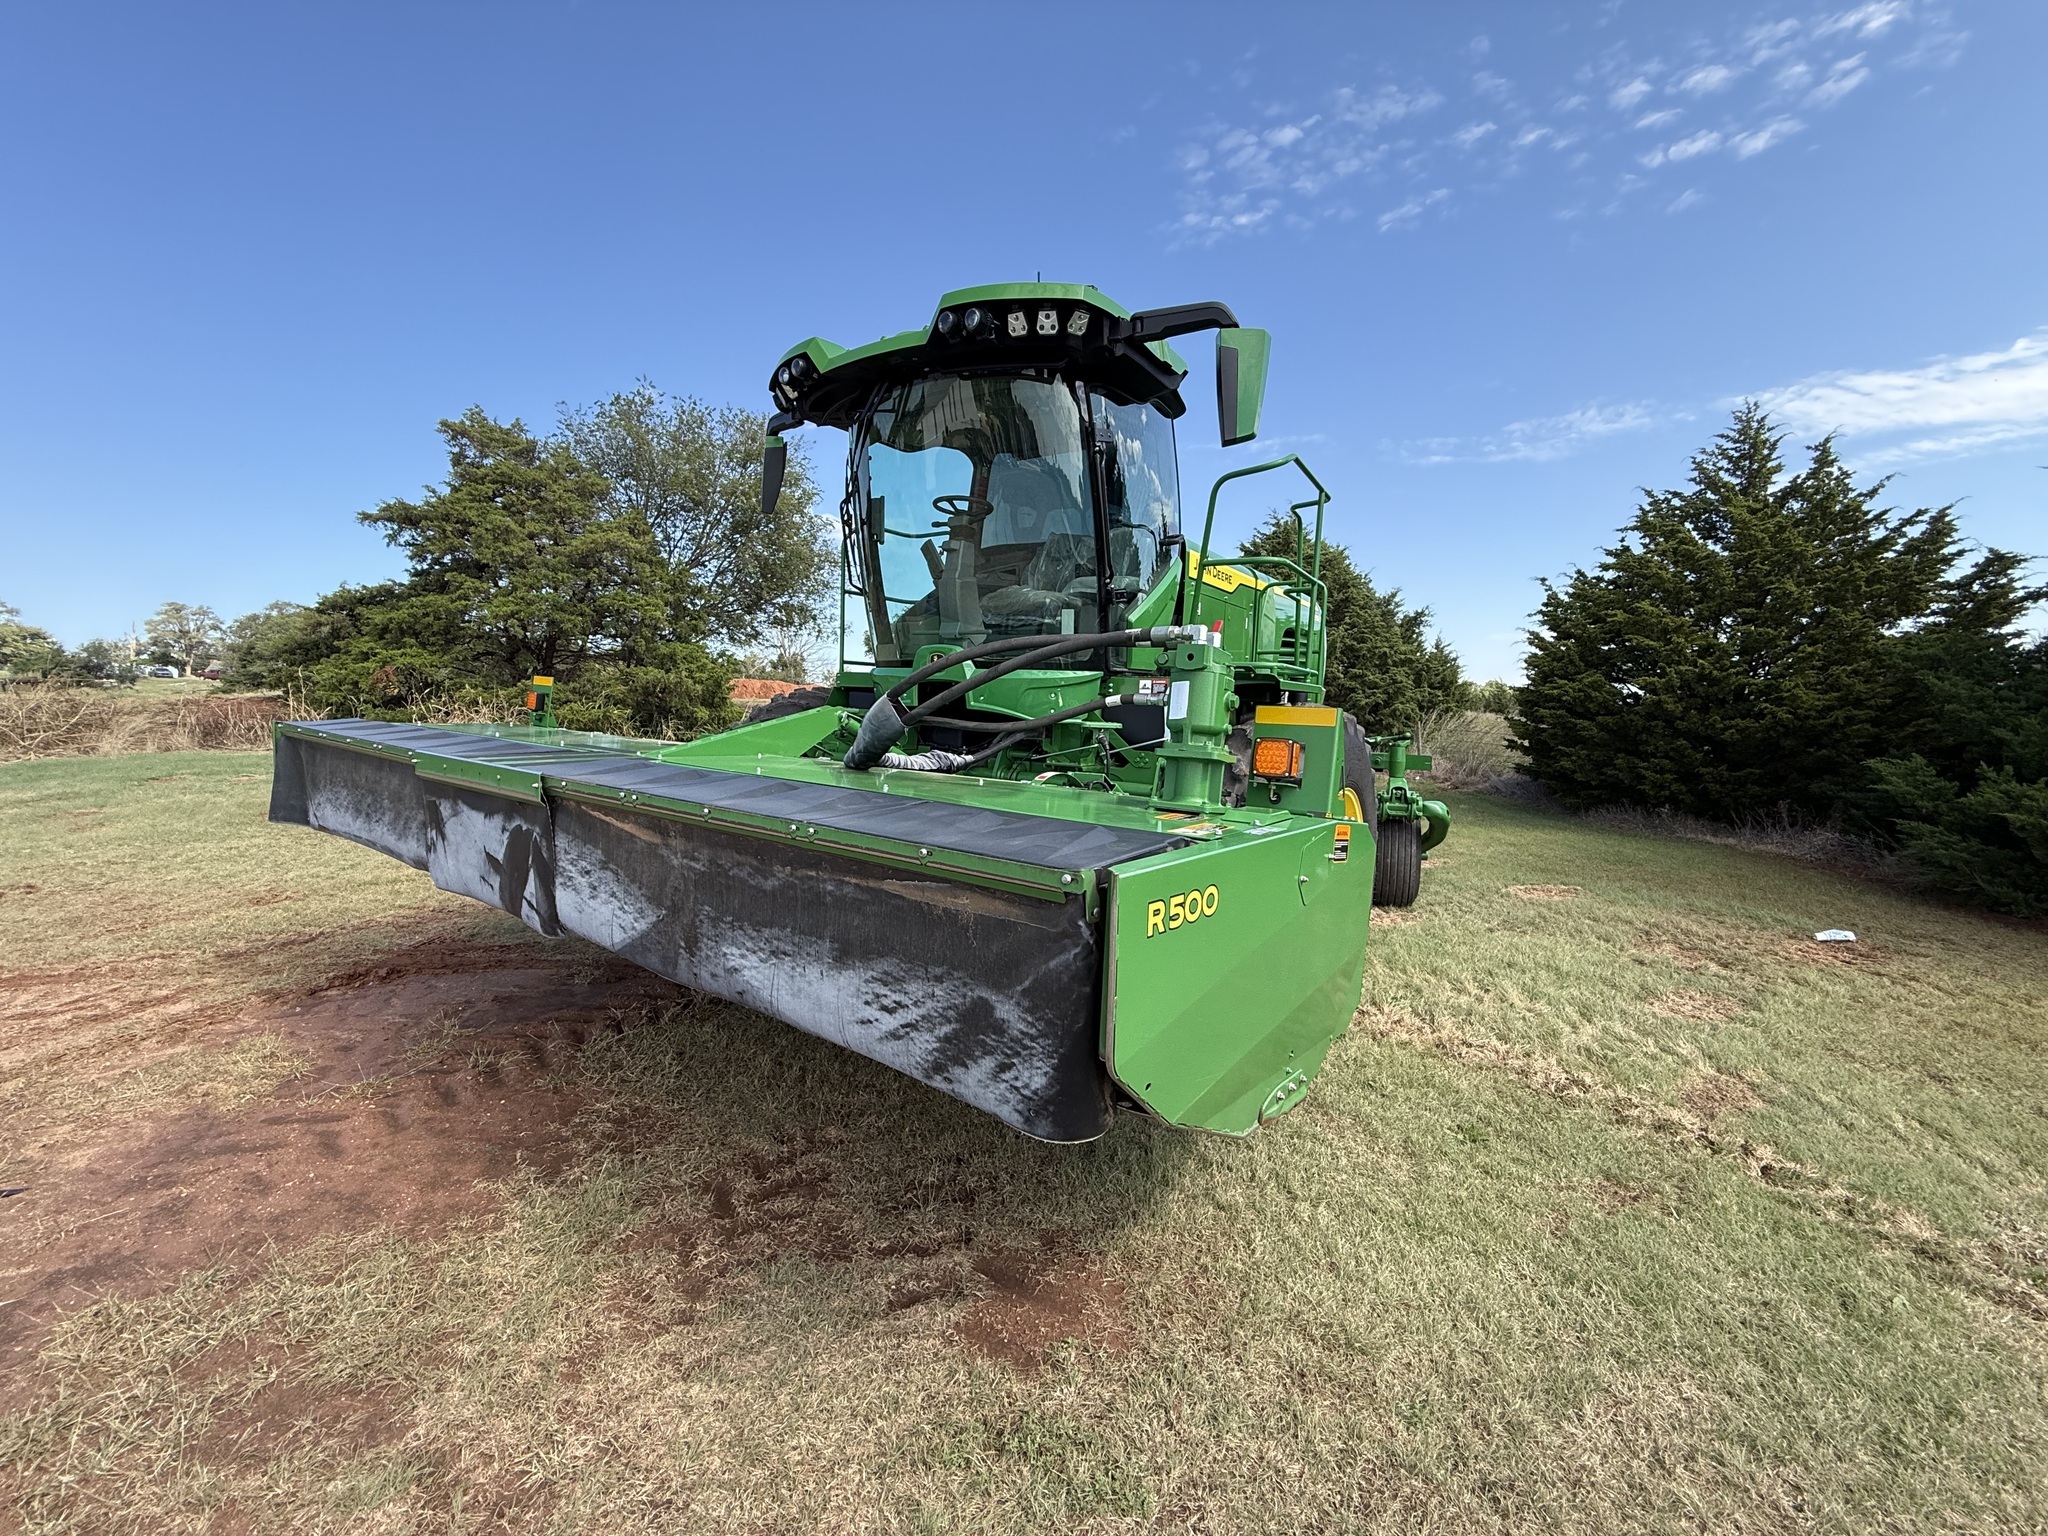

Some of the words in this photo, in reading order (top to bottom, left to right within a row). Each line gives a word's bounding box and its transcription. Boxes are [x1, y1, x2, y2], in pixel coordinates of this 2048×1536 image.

[1194, 559, 1212, 577] JN
[1212, 565, 1233, 585] DEERE
[1147, 883, 1219, 938] R500
